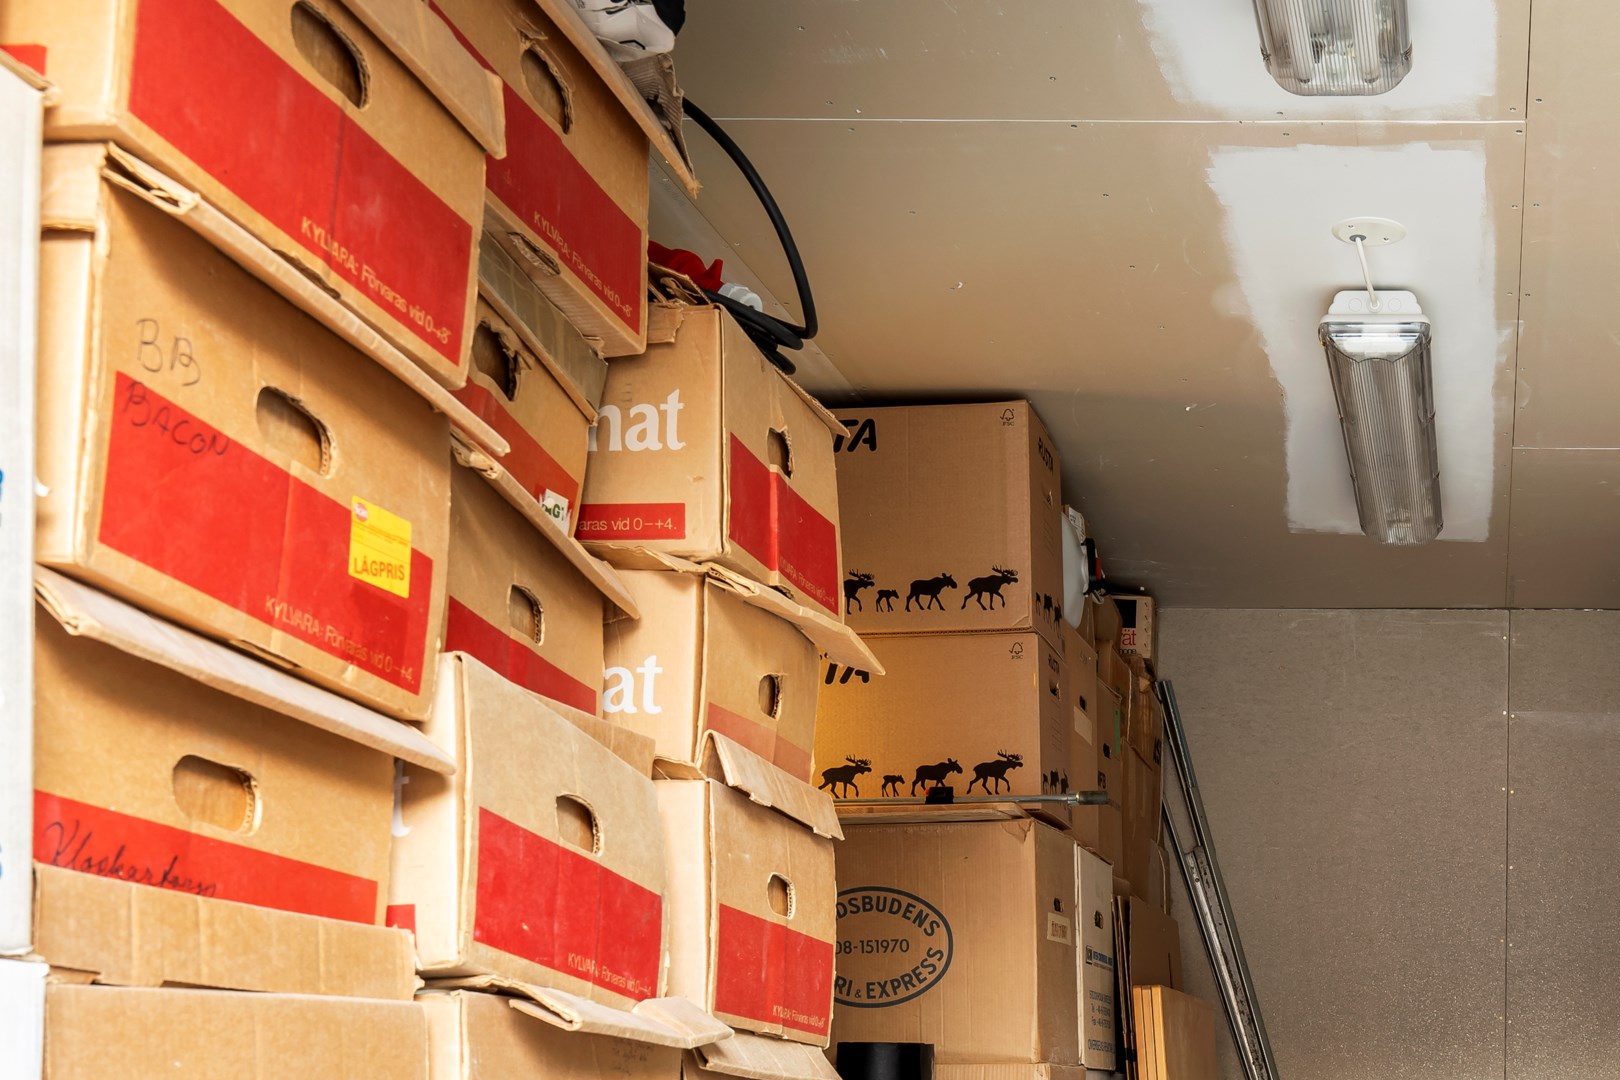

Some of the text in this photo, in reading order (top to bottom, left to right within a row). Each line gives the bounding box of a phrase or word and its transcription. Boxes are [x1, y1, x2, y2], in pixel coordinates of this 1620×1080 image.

[123, 380, 231, 456] BACON
[1037, 436, 1054, 475] RUSTA
[611, 517, 630, 531] vid
[353, 554, 406, 581] LÅGPRIS
[854, 989, 862, 999] &
[866, 946, 944, 1000] EXPRESS
